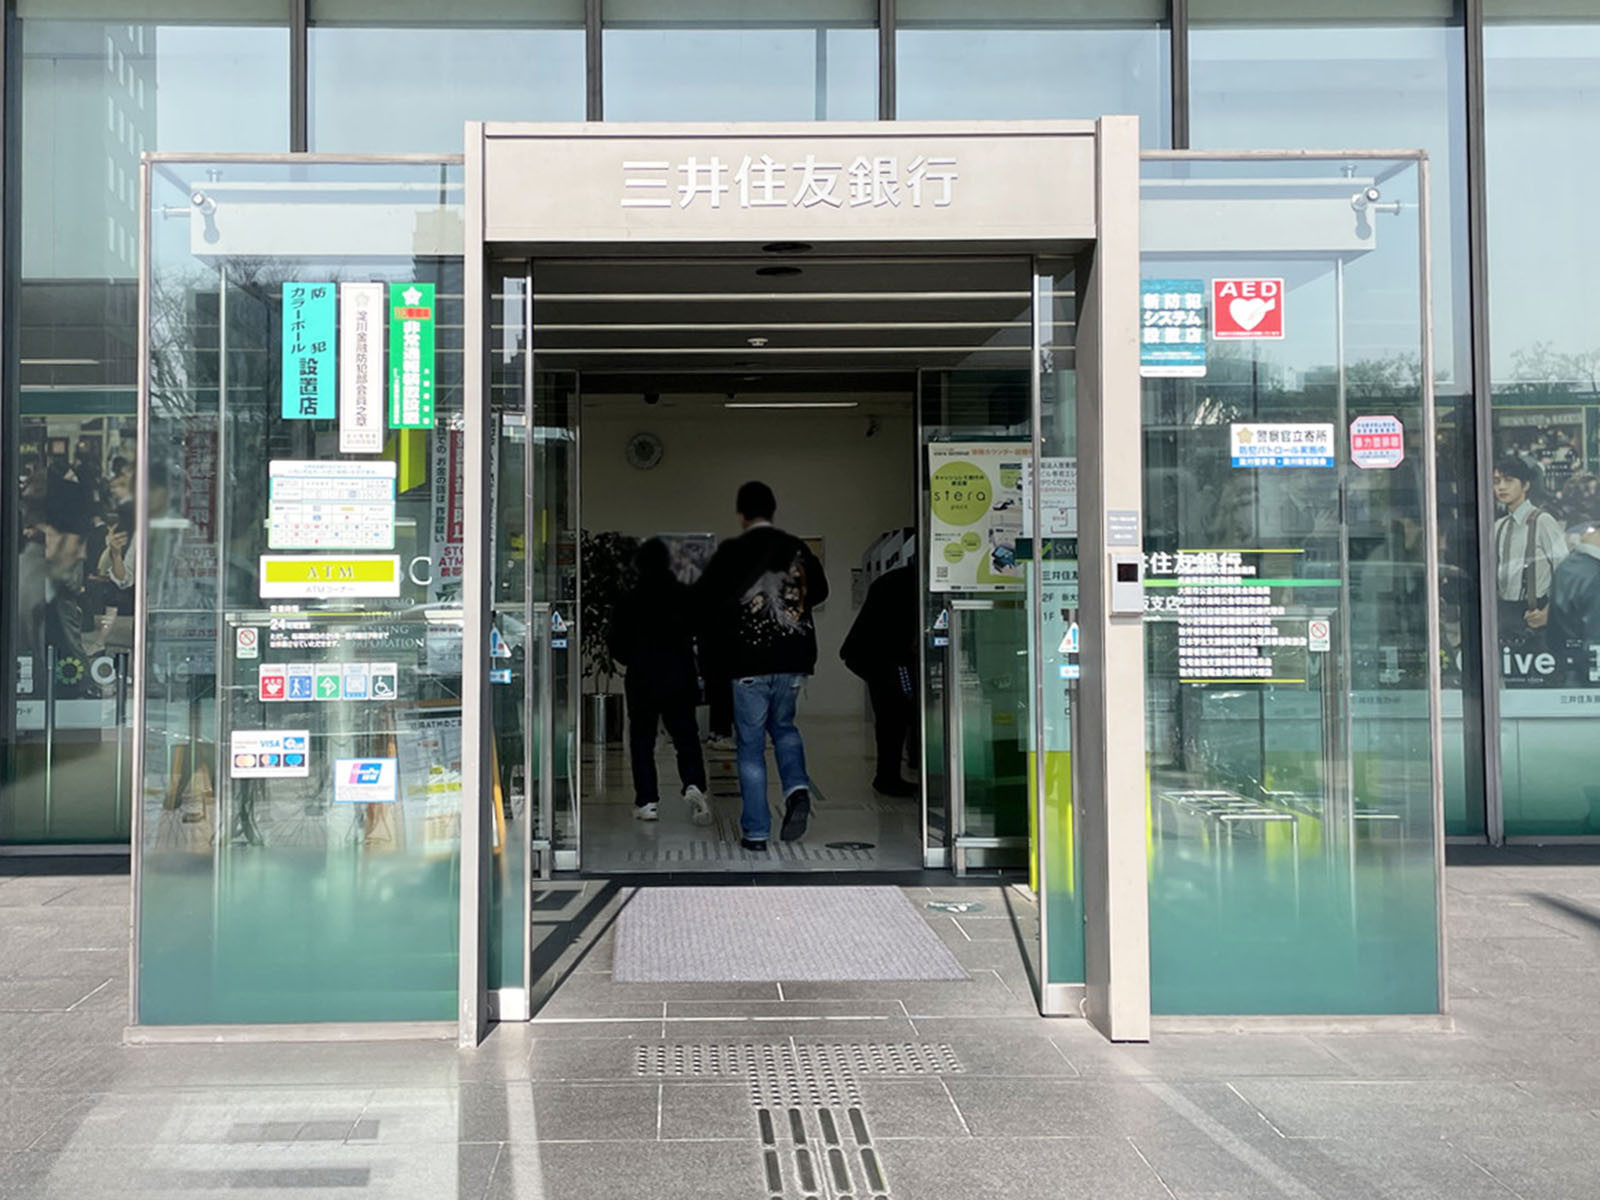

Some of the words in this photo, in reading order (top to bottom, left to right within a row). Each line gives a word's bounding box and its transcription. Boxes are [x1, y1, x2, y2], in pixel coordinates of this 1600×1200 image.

[621, 154, 958, 209] 三井住友銀行
[1219, 281, 1277, 297] AED
[290, 287, 306, 354] カラーボール
[1143, 310, 1202, 327] システム
[299, 357, 318, 416] 設置店
[1256, 429, 1328, 443] 警察官立寄所
[934, 490, 986, 501] stera
[306, 565, 355, 580] ATM
[1042, 592, 1055, 603] 2F
[1043, 611, 1055, 621] 1F
[260, 740, 280, 748] VISA
